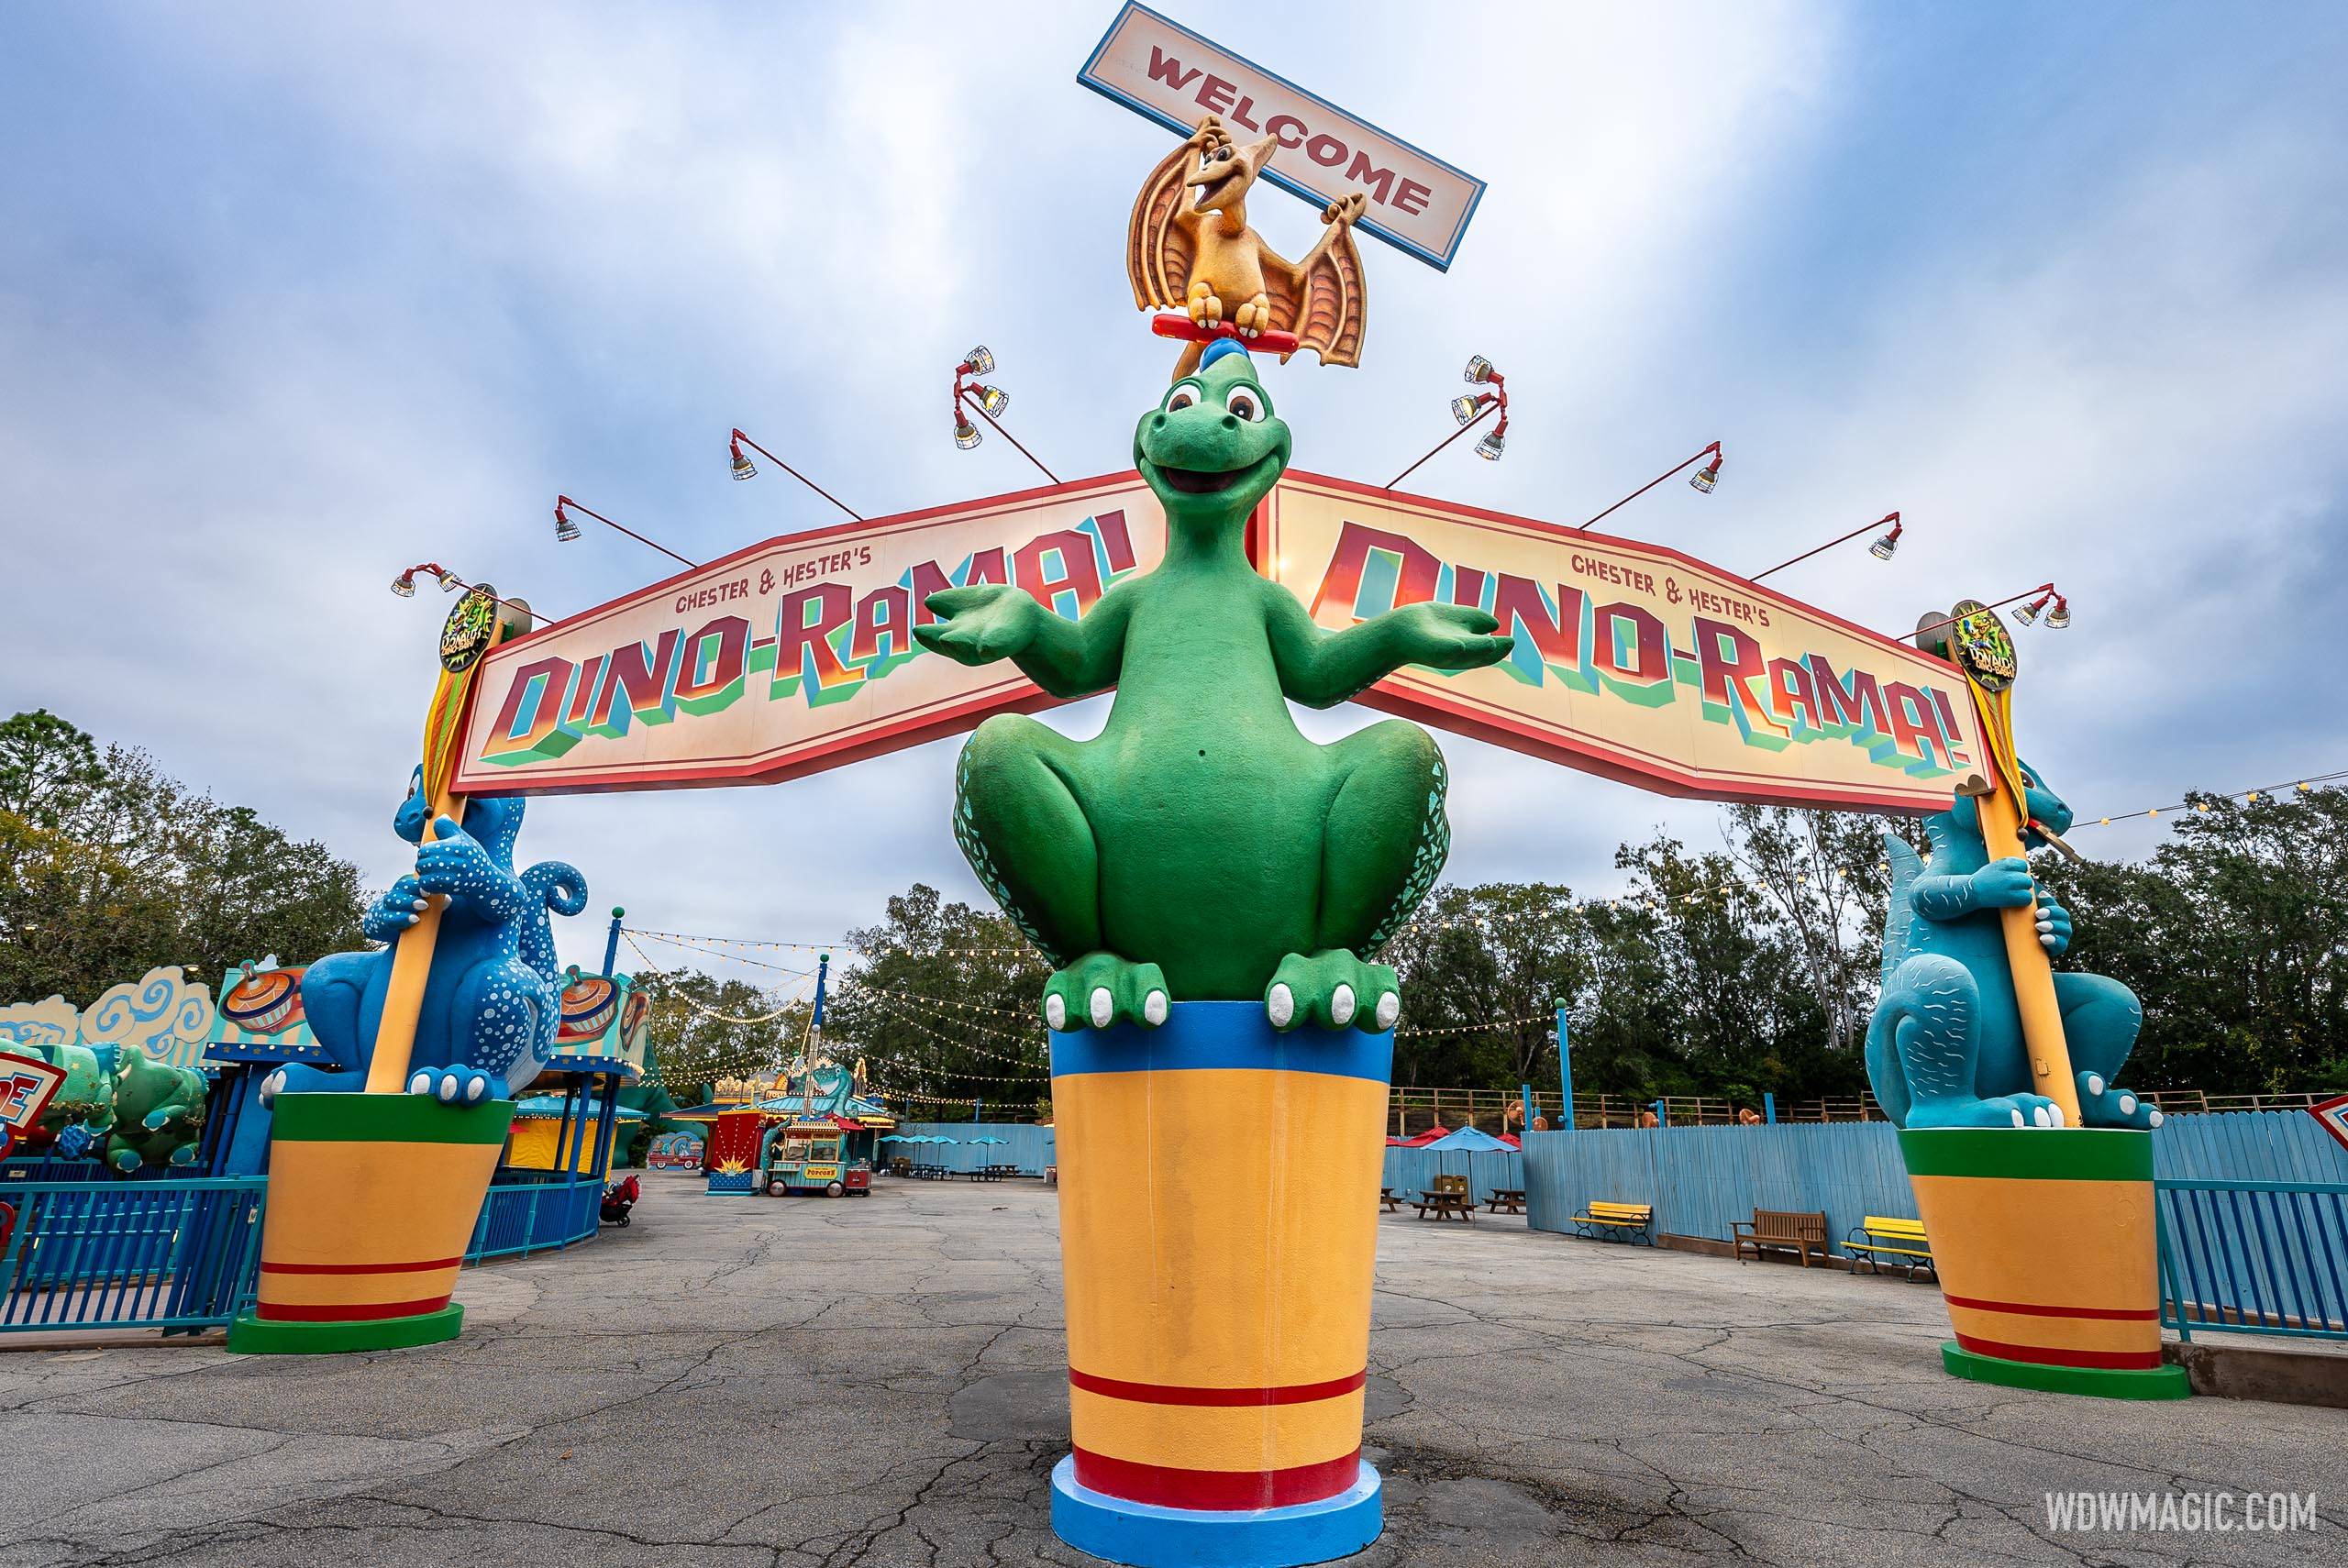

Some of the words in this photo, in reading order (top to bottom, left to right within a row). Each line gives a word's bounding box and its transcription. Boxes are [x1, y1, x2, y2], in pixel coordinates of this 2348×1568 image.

[1148, 44, 1433, 216] WELCOME
[676, 579, 749, 613] CHESTER
[759, 568, 776, 595] &
[783, 547, 872, 589] HESTER'S
[1571, 554, 1656, 597] CHESTER
[1665, 576, 1683, 604] &
[1689, 588, 1771, 627] HESTER'S
[807, 1166, 836, 1176] POPCORN
